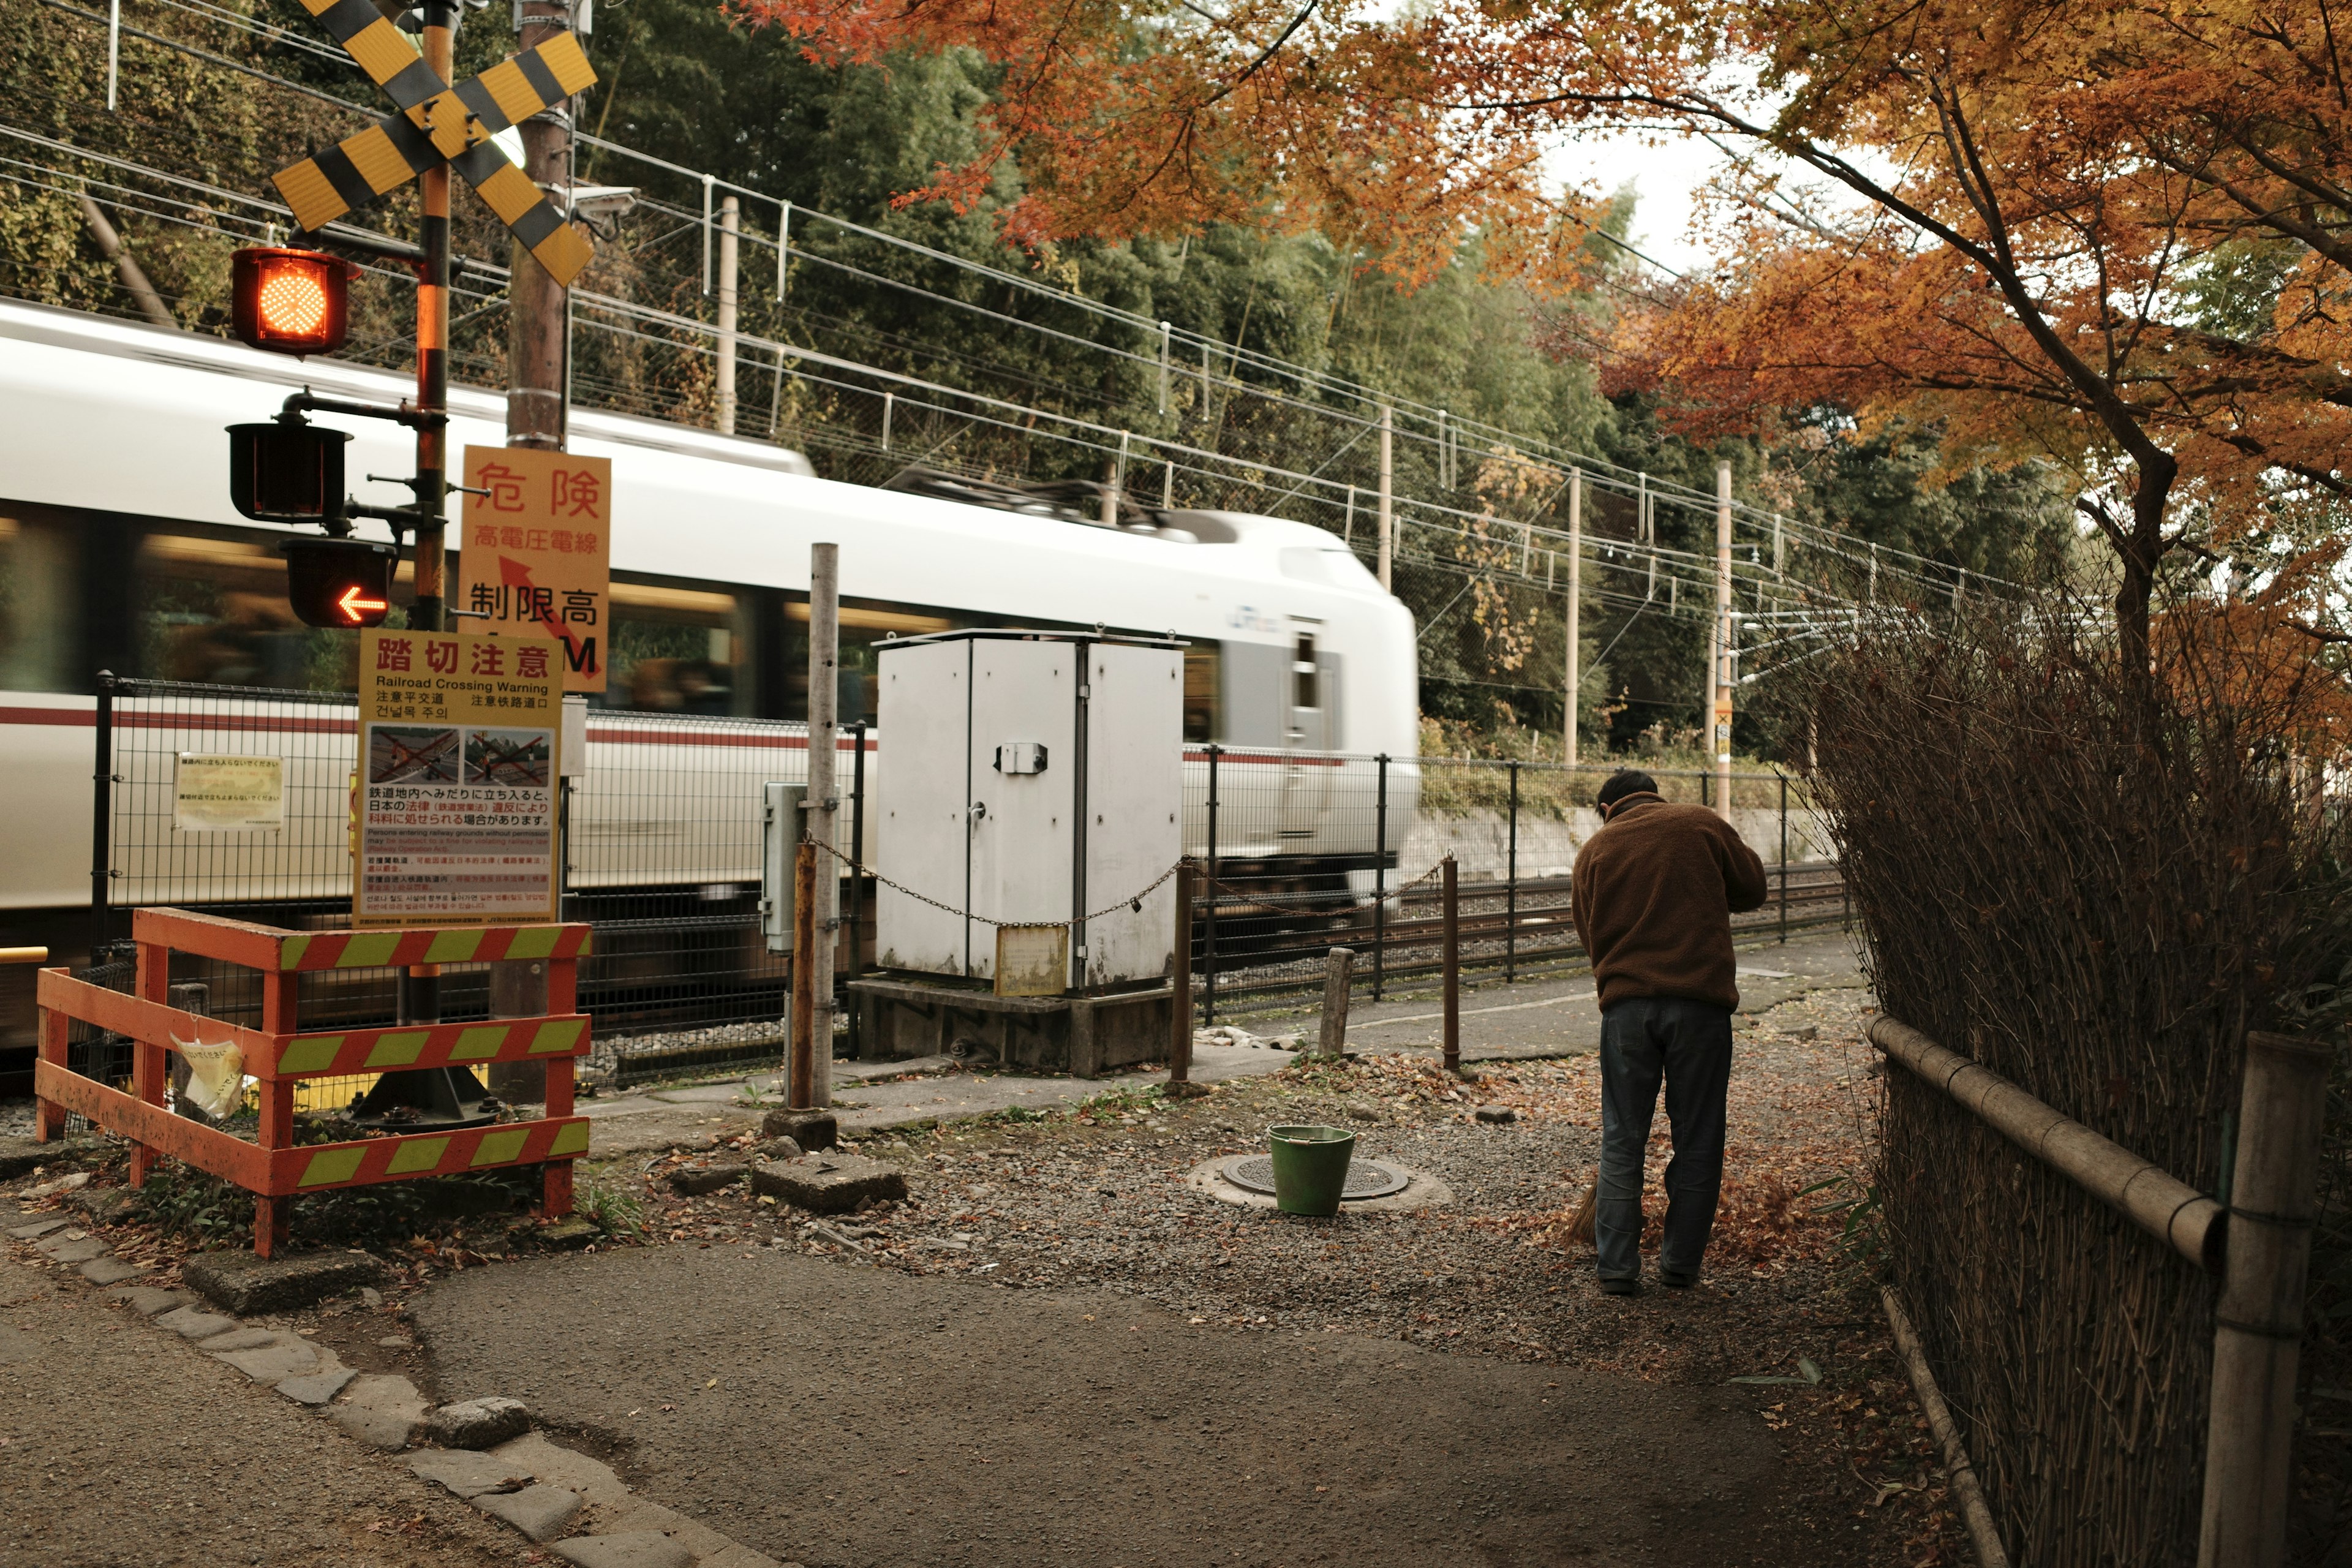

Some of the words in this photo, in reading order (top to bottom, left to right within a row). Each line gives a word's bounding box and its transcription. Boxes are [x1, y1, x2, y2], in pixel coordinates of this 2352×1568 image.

[475, 462, 600, 519] 危険
[475, 525, 598, 555] 高電圧電線
[470, 583, 598, 626] 制限高
[376, 638, 549, 679] 踏切注意
[559, 635, 596, 673] M
[376, 690, 444, 704] 注意平交道
[377, 676, 431, 688] Railroad
[435, 678, 492, 693] Crossing
[497, 682, 548, 696] Warning
[376, 705, 416, 718] 건널목
[422, 707, 447, 720] 주의
[471, 695, 548, 708] 注意铁路道口
[369, 787, 548, 801] 鉄道地内へみだりに立ち入ると、
